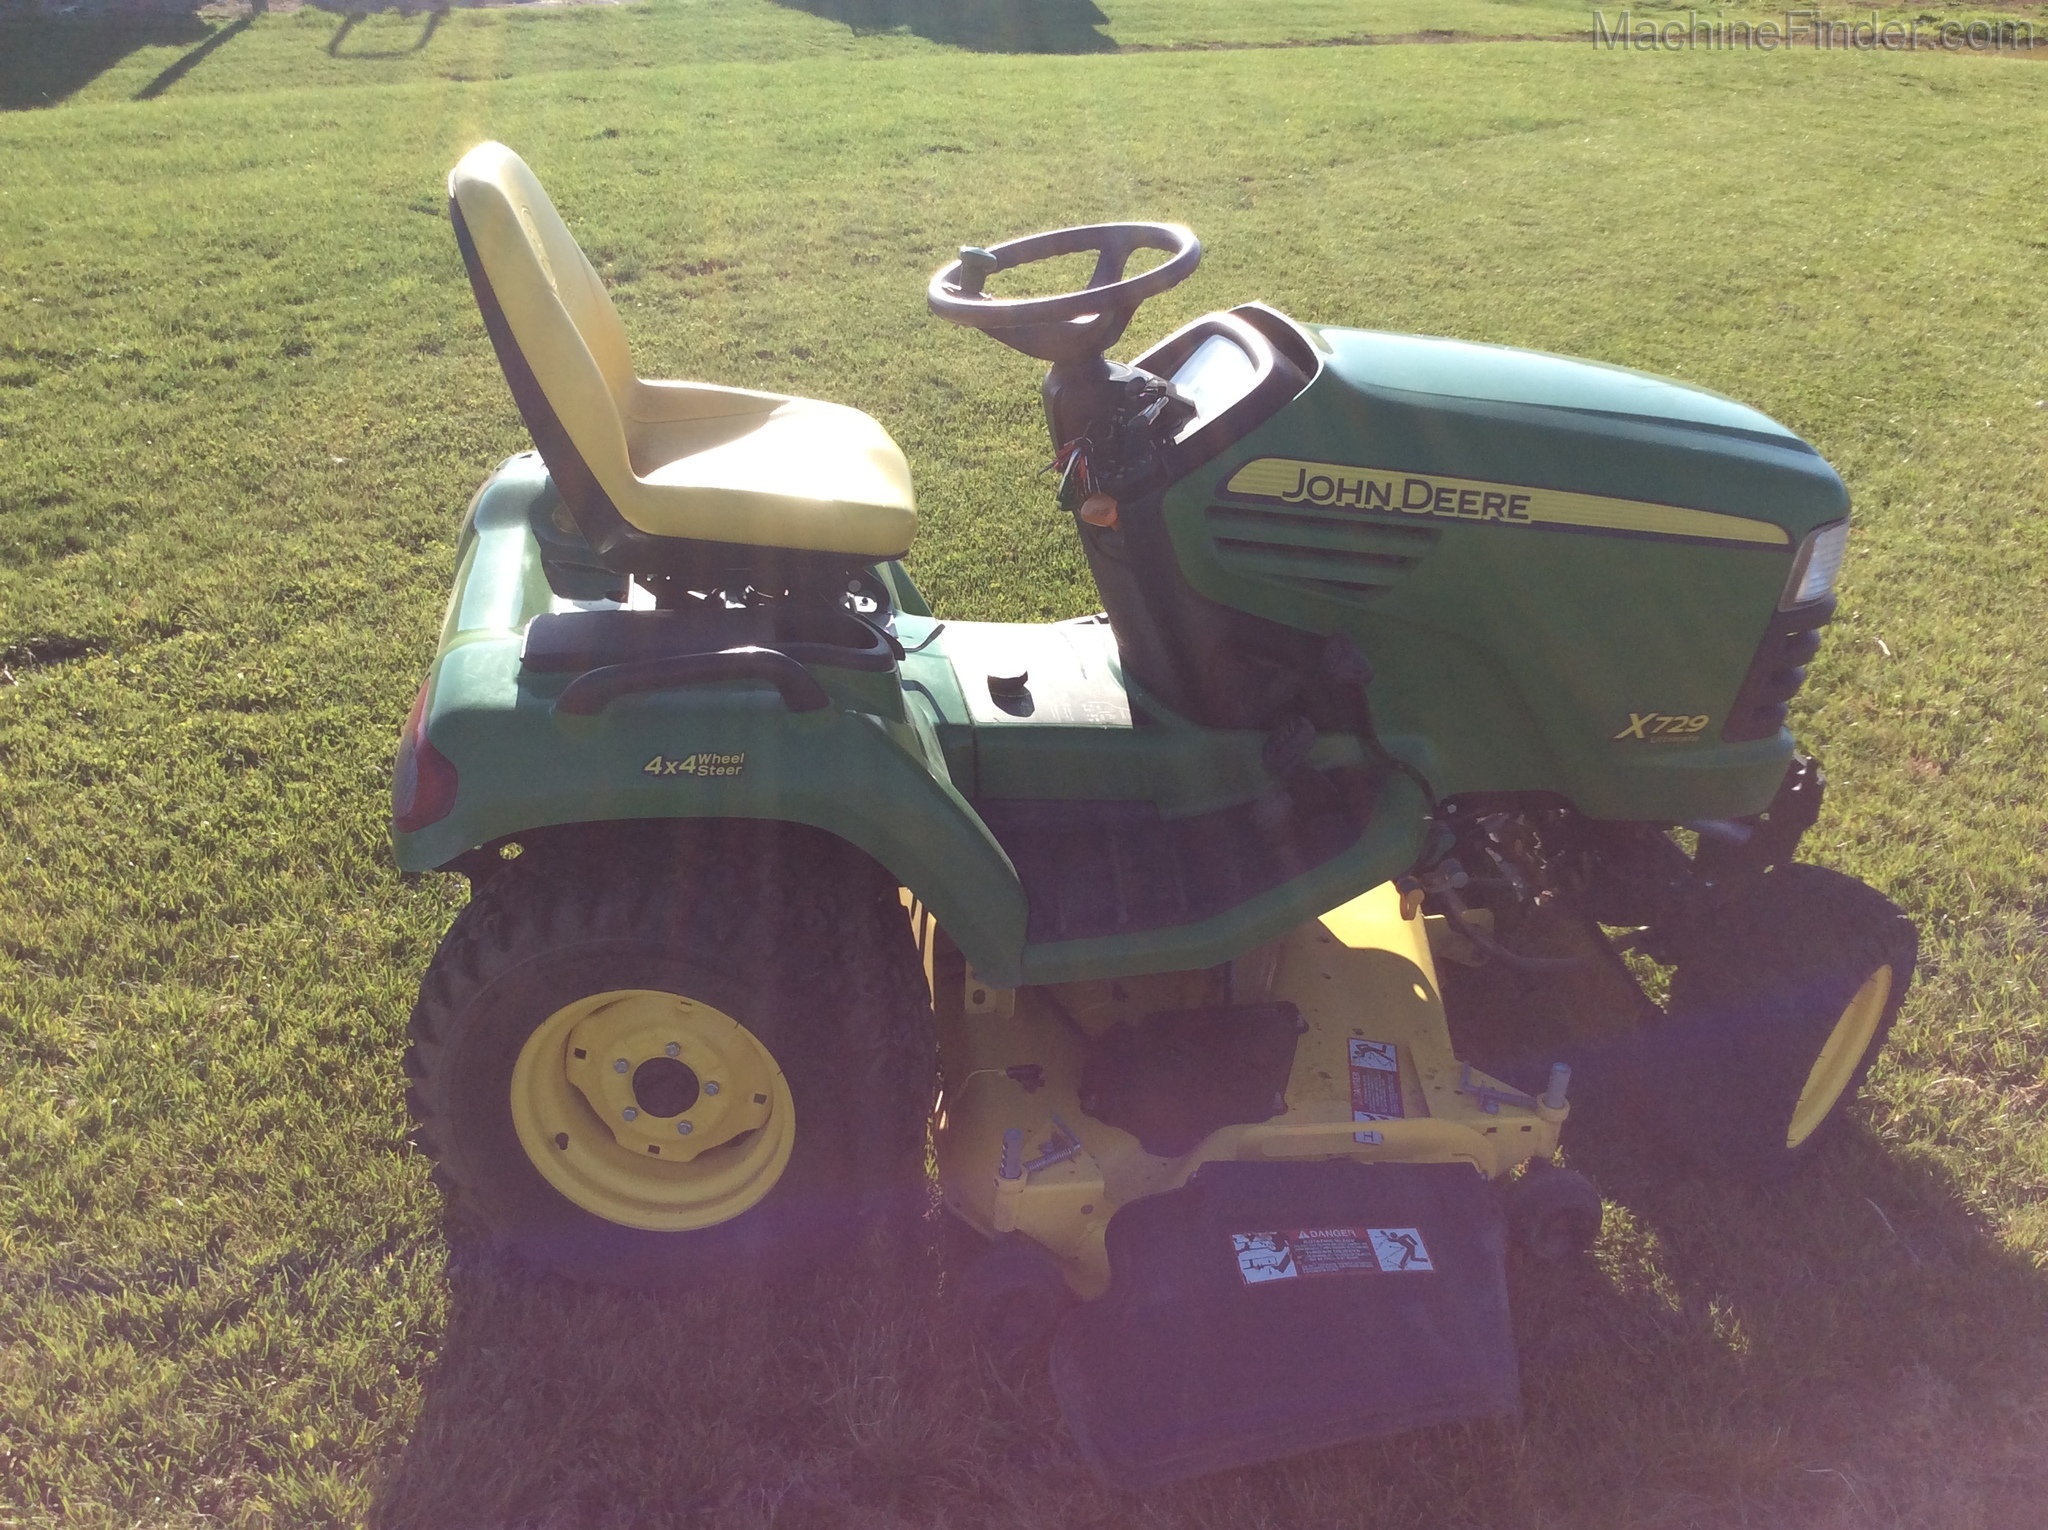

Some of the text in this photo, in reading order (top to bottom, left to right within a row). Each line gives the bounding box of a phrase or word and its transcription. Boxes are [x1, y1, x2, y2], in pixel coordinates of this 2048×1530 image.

[1282, 468, 1531, 520] JOHN DEERE
[1613, 712, 1710, 739] X729
[644, 754, 696, 775] 4x4
[698, 752, 745, 765] Wheel
[697, 764, 742, 776] Steer
[1309, 1229, 1356, 1238] DANGER
